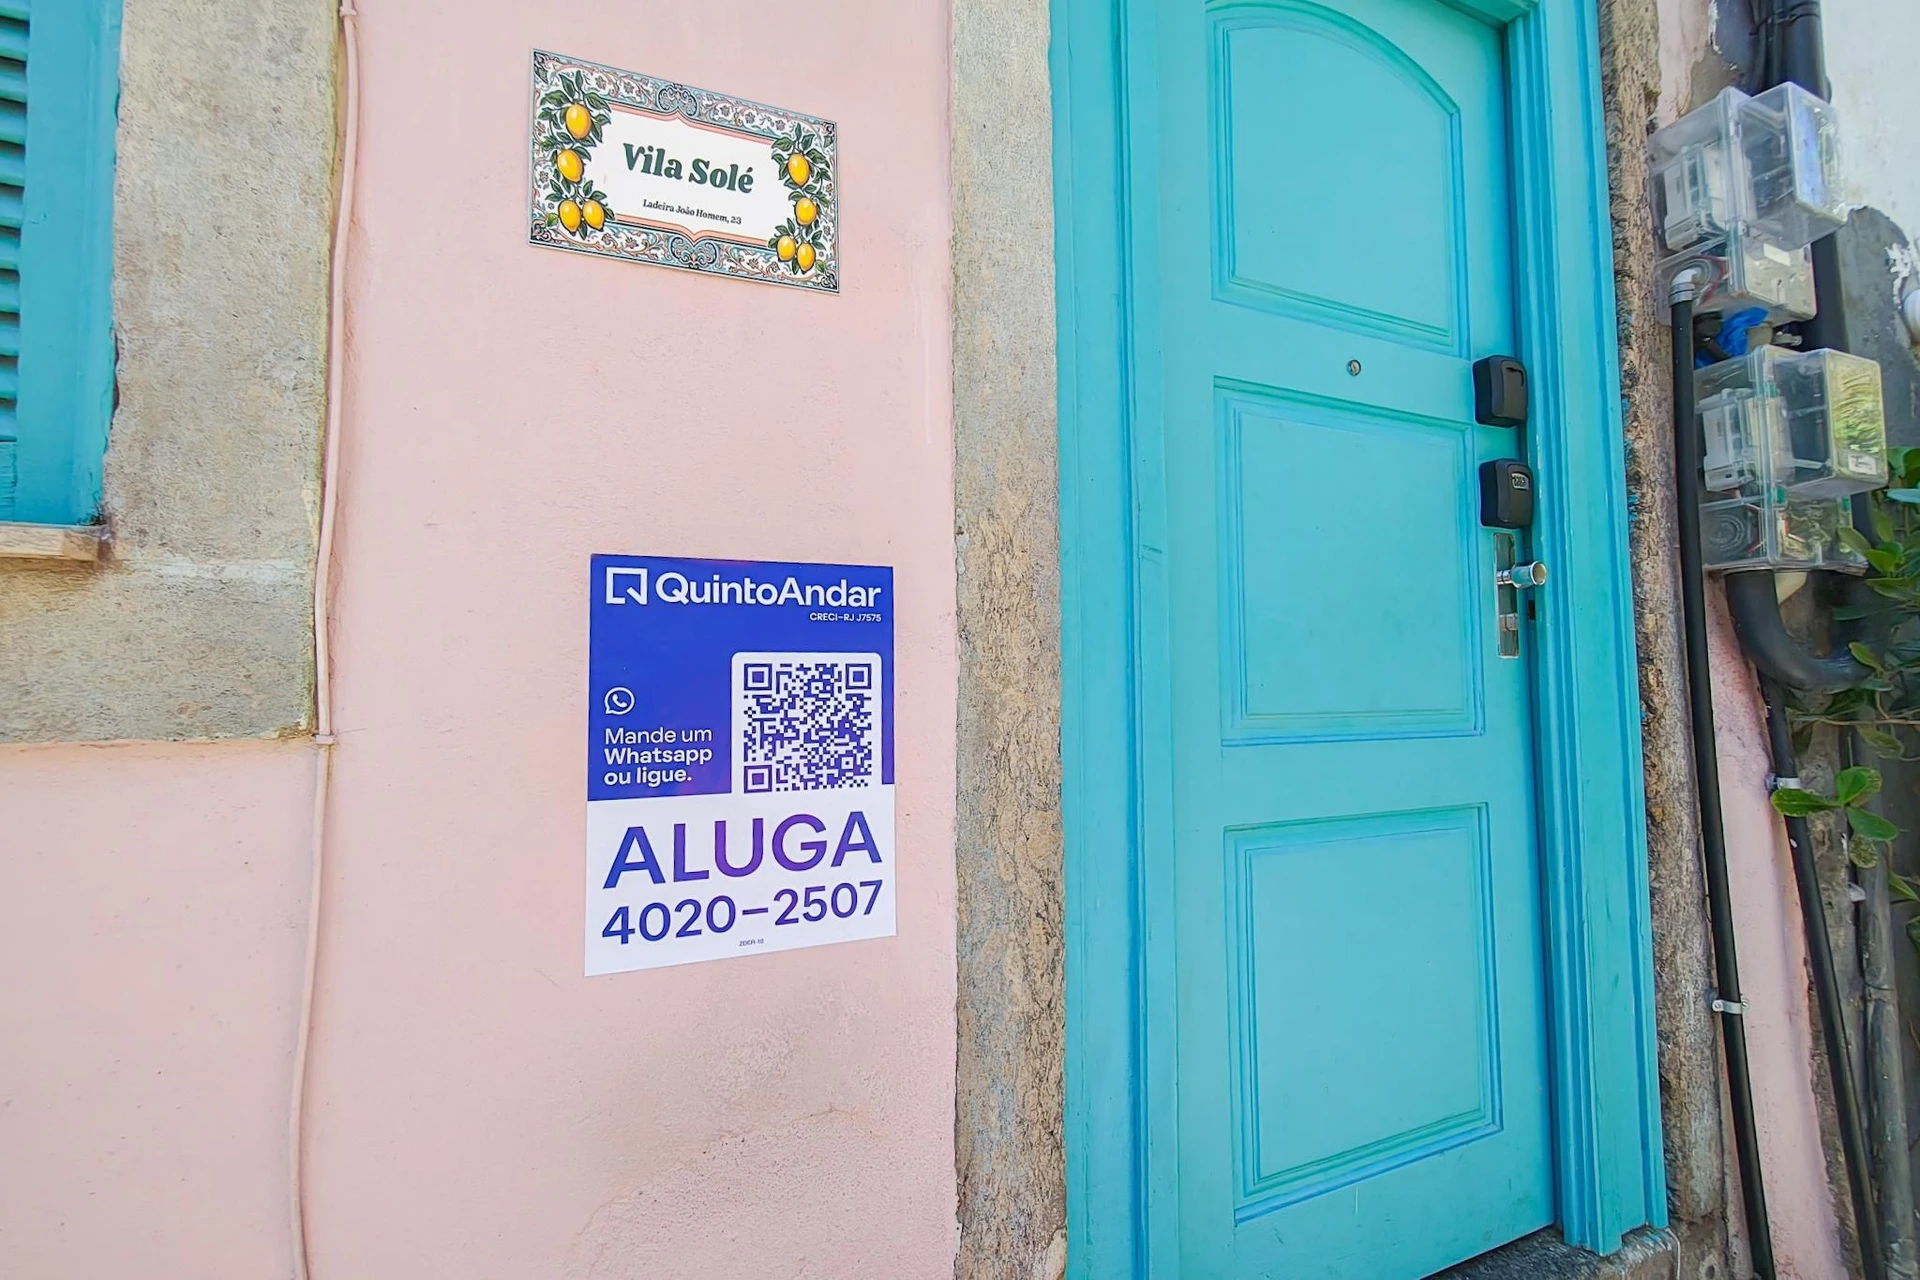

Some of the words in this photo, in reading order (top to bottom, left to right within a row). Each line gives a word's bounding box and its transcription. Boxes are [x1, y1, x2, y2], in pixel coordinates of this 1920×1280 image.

[623, 143, 683, 181] Vila
[688, 157, 754, 193] Solé
[643, 199, 675, 212] Ladeira
[675, 205, 695, 216] João
[696, 209, 729, 224] Homem,
[730, 216, 742, 225] 23
[655, 572, 881, 608] QuintoAndar
[809, 612, 855, 622] CRECI-RJ
[856, 613, 882, 622] J7575
[605, 727, 676, 745] Mande
[681, 728, 712, 743] um
[604, 747, 713, 765] Whatsapp
[604, 769, 630, 785] ou
[636, 766, 692, 787] ligue.
[603, 811, 882, 889] ALUGA
[602, 880, 883, 945] 4020-2507
